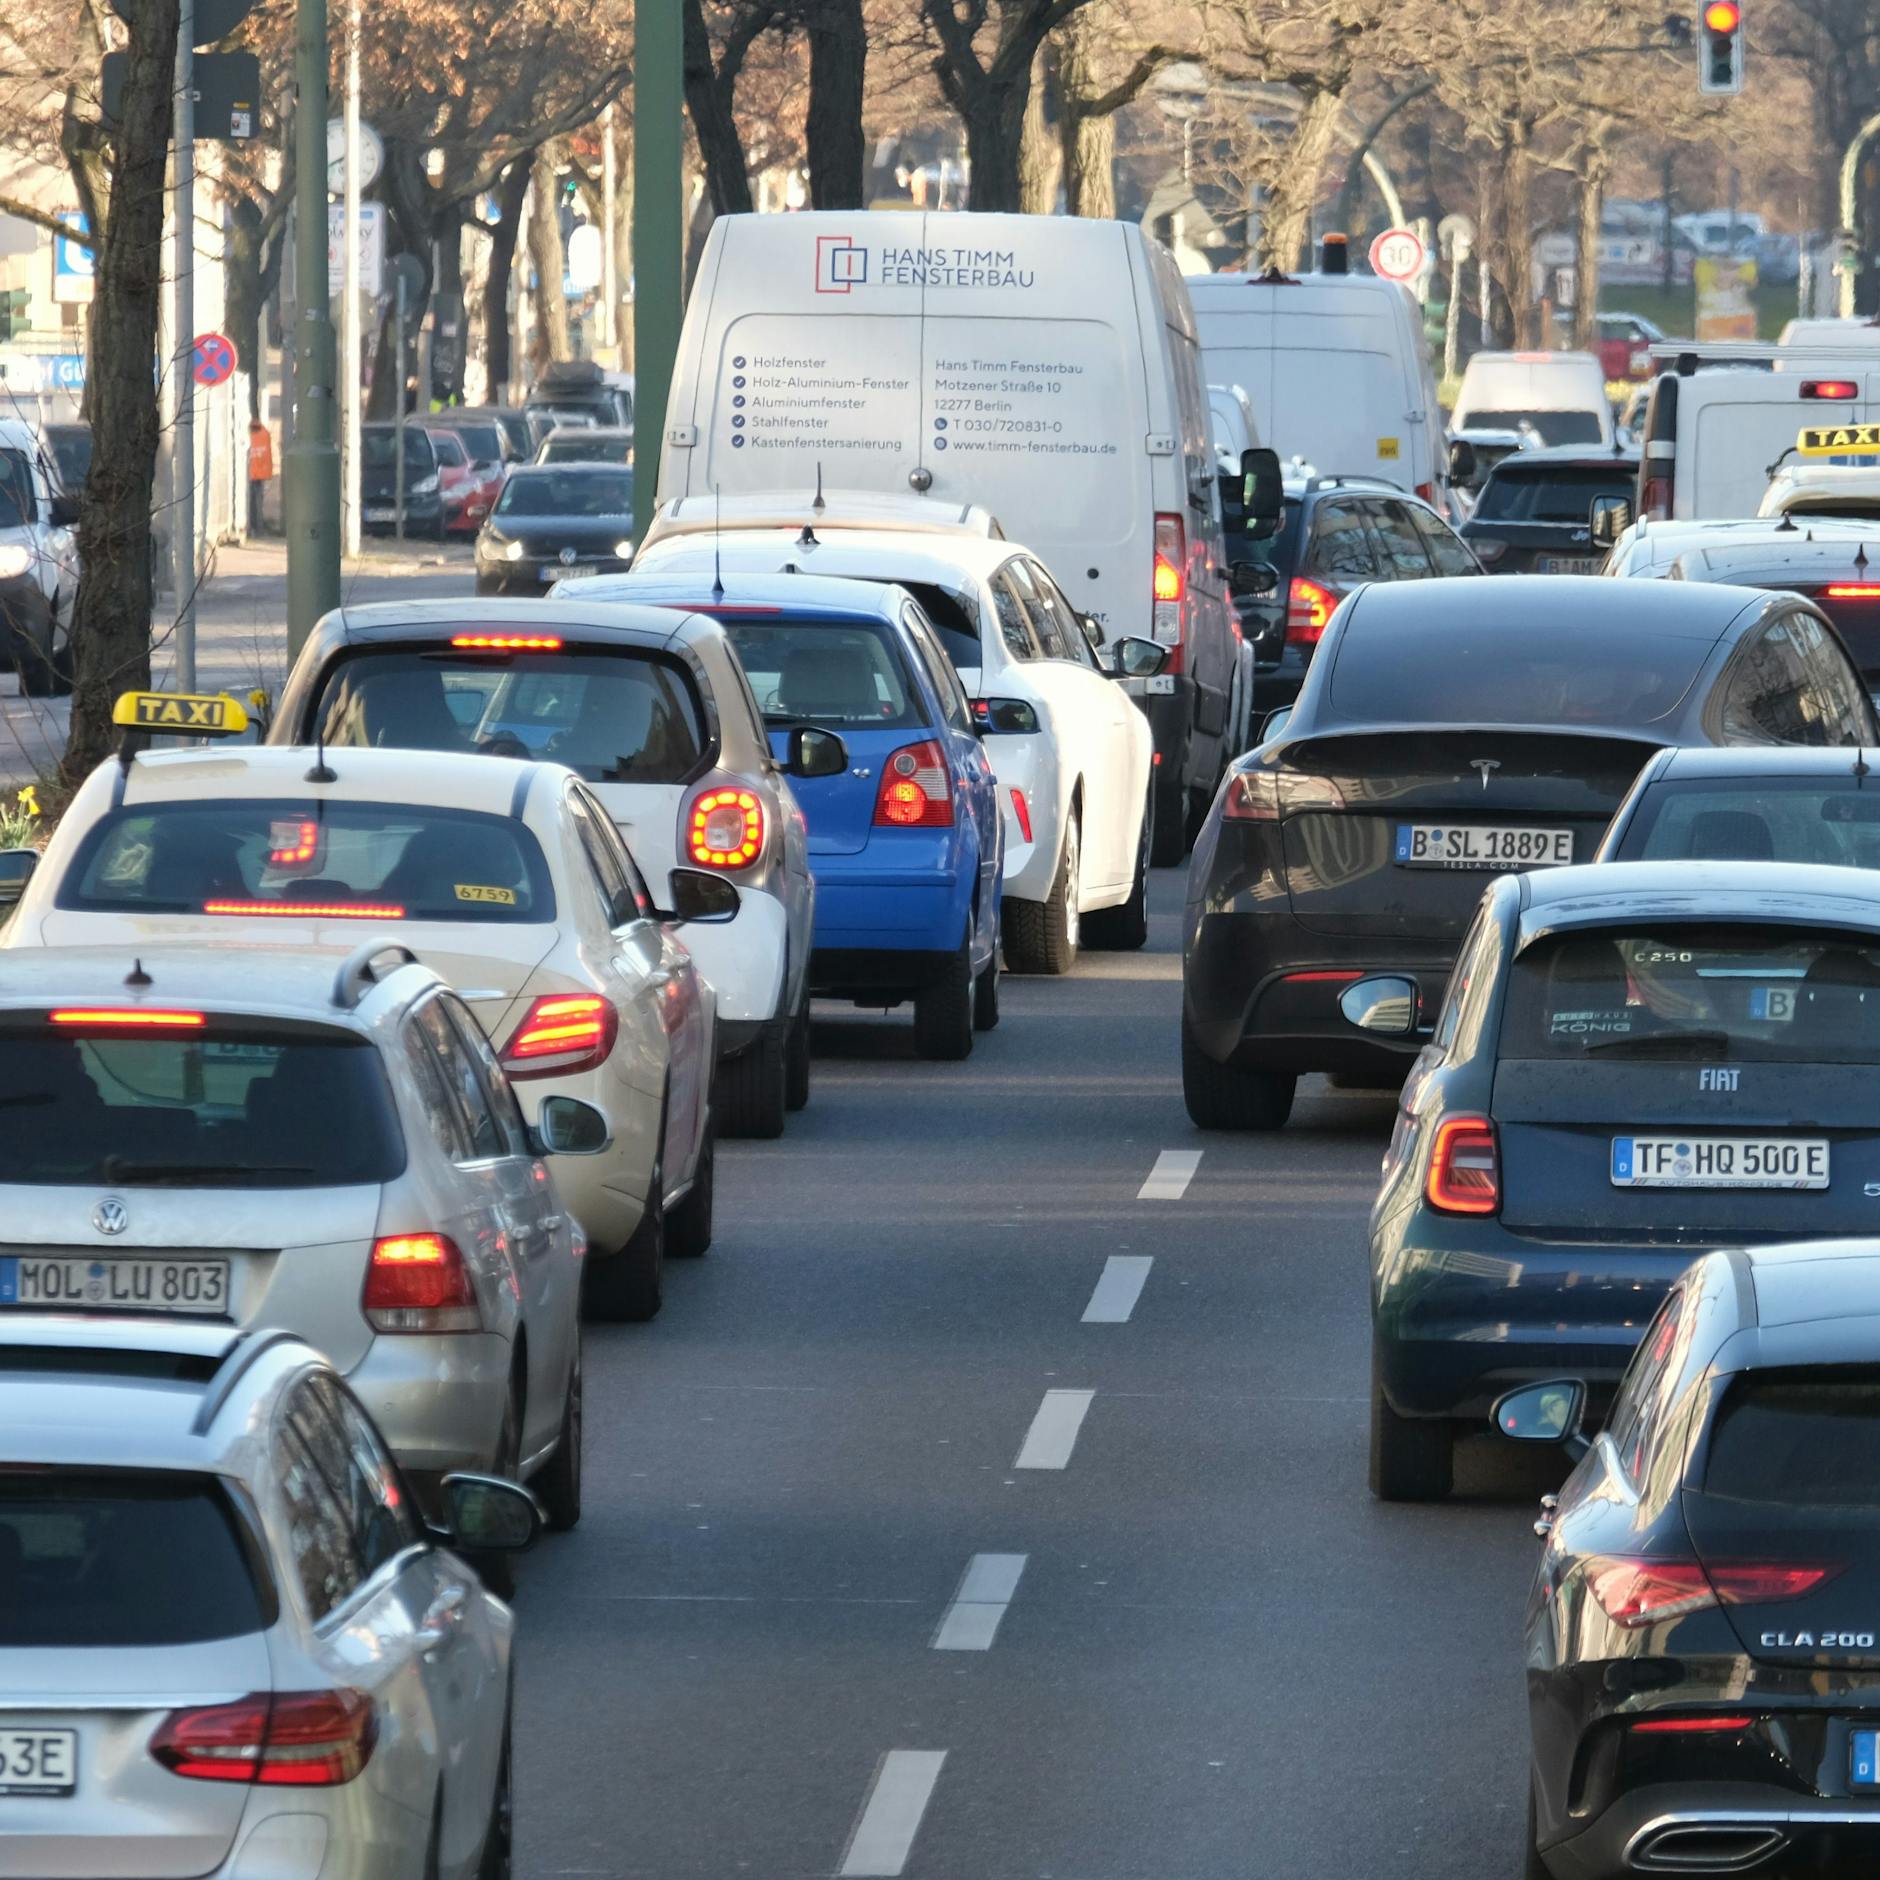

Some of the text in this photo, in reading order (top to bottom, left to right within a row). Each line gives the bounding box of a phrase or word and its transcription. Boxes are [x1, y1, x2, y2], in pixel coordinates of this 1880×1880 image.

[882, 248, 1014, 268] HANS TIMM
[1383, 245, 1411, 265] 30
[882, 267, 1035, 288] FENSTERBAU
[754, 357, 826, 369] Holzfenster
[935, 360, 1083, 375] Hans Timm Fensterbau
[753, 376, 910, 390] Holz-Aluminium-Fenster
[935, 379, 1062, 394] Motzener Straße 10
[752, 397, 866, 409] Aluminiumfenster
[934, 399, 1012, 412] 12277 Berlin
[752, 416, 829, 429] Stahlfenster
[953, 419, 1063, 433] T 030/720831-0
[751, 436, 902, 452] Kastenfenstersanierung
[1815, 428, 1880, 447] TAX
[953, 441, 1117, 455] www.timm-fensterbau.de
[140, 698, 222, 725] TAXI
[1412, 830, 1427, 857] B
[1446, 830, 1479, 859] SL
[1443, 861, 1519, 870] TESLA.COM
[460, 887, 510, 901] 6759
[1634, 952, 1693, 963] C 250
[1769, 991, 1789, 1018] B
[1550, 1021, 1631, 1034] KÖNIG
[1700, 1069, 1741, 1092] FIAT
[1636, 1143, 1672, 1174] TF
[1695, 1144, 1734, 1176] HQ
[21, 1263, 82, 1299] MOL
[109, 1266, 151, 1300] LU
[162, 1266, 223, 1301] 803
[1760, 1631, 1874, 1647] CLA 200
